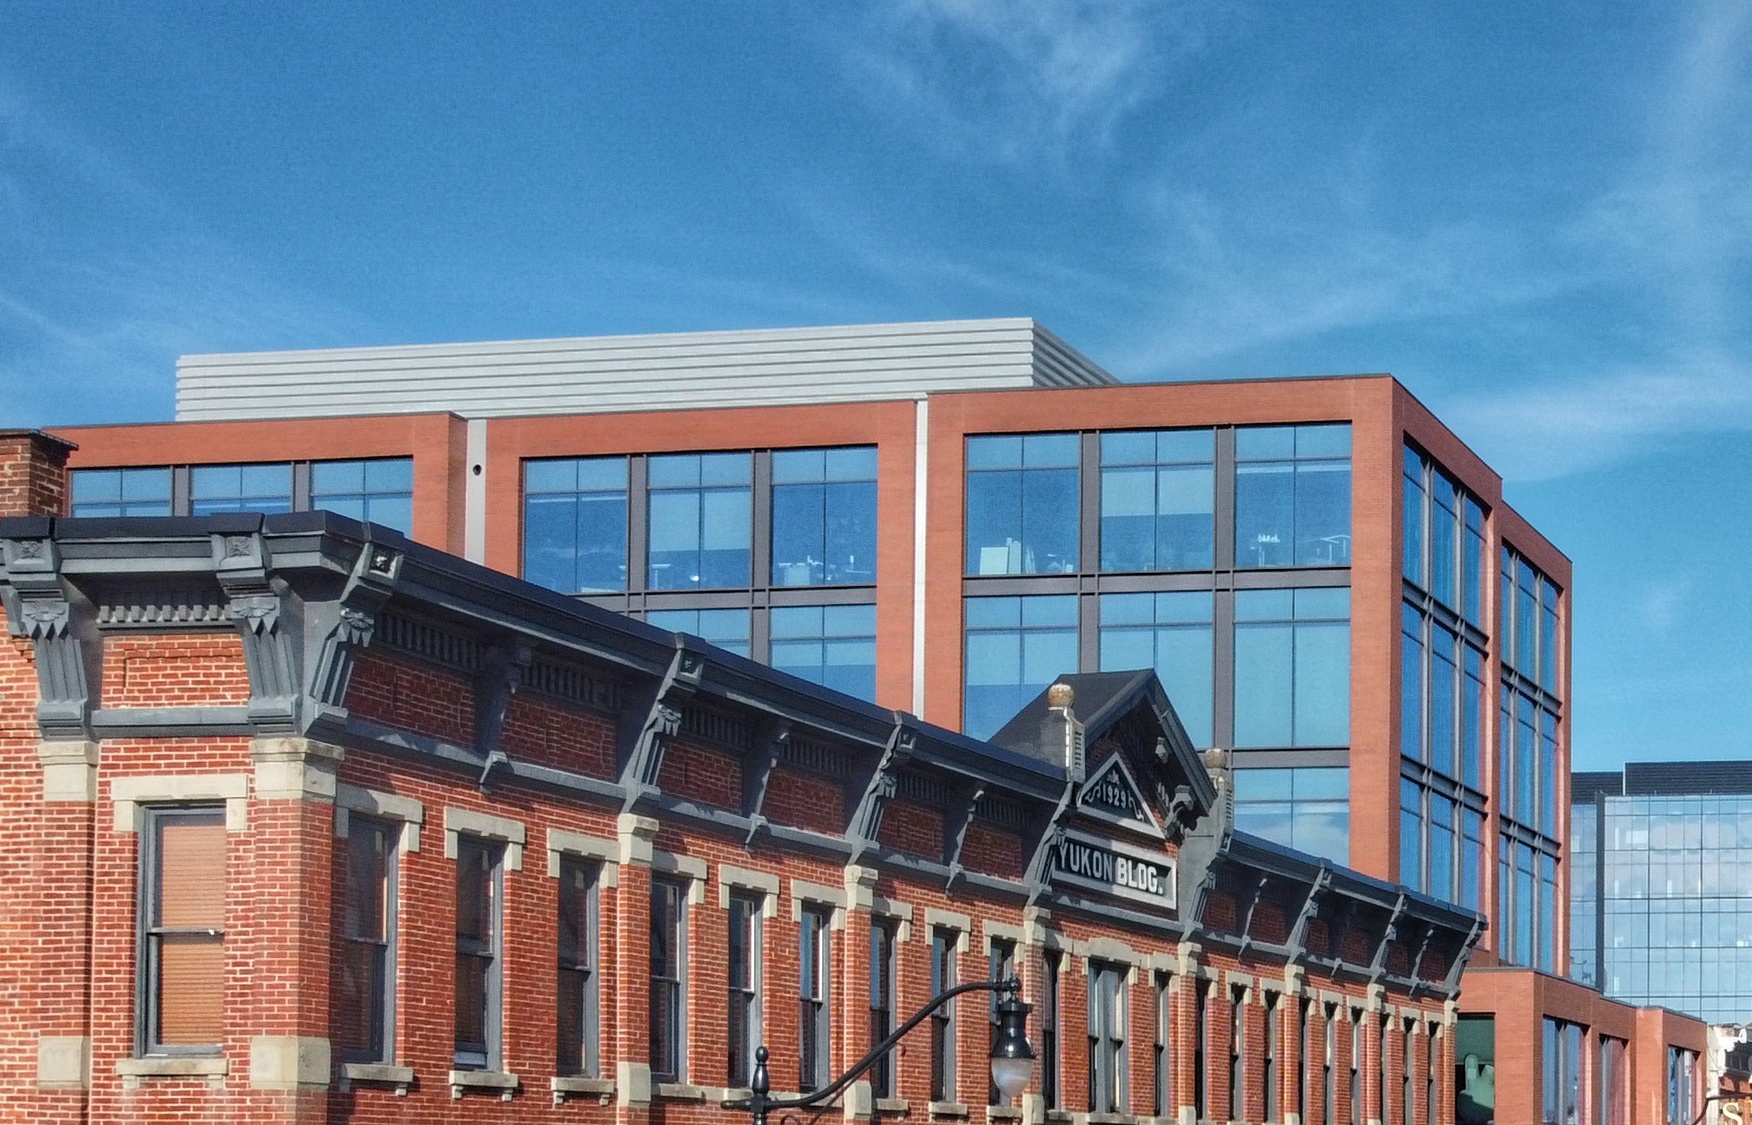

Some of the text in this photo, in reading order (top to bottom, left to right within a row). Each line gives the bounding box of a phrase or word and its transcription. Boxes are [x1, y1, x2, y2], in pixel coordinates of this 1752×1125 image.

[1102, 783, 1127, 808] 1929
[1060, 841, 1164, 894] YUKON BLDG.
